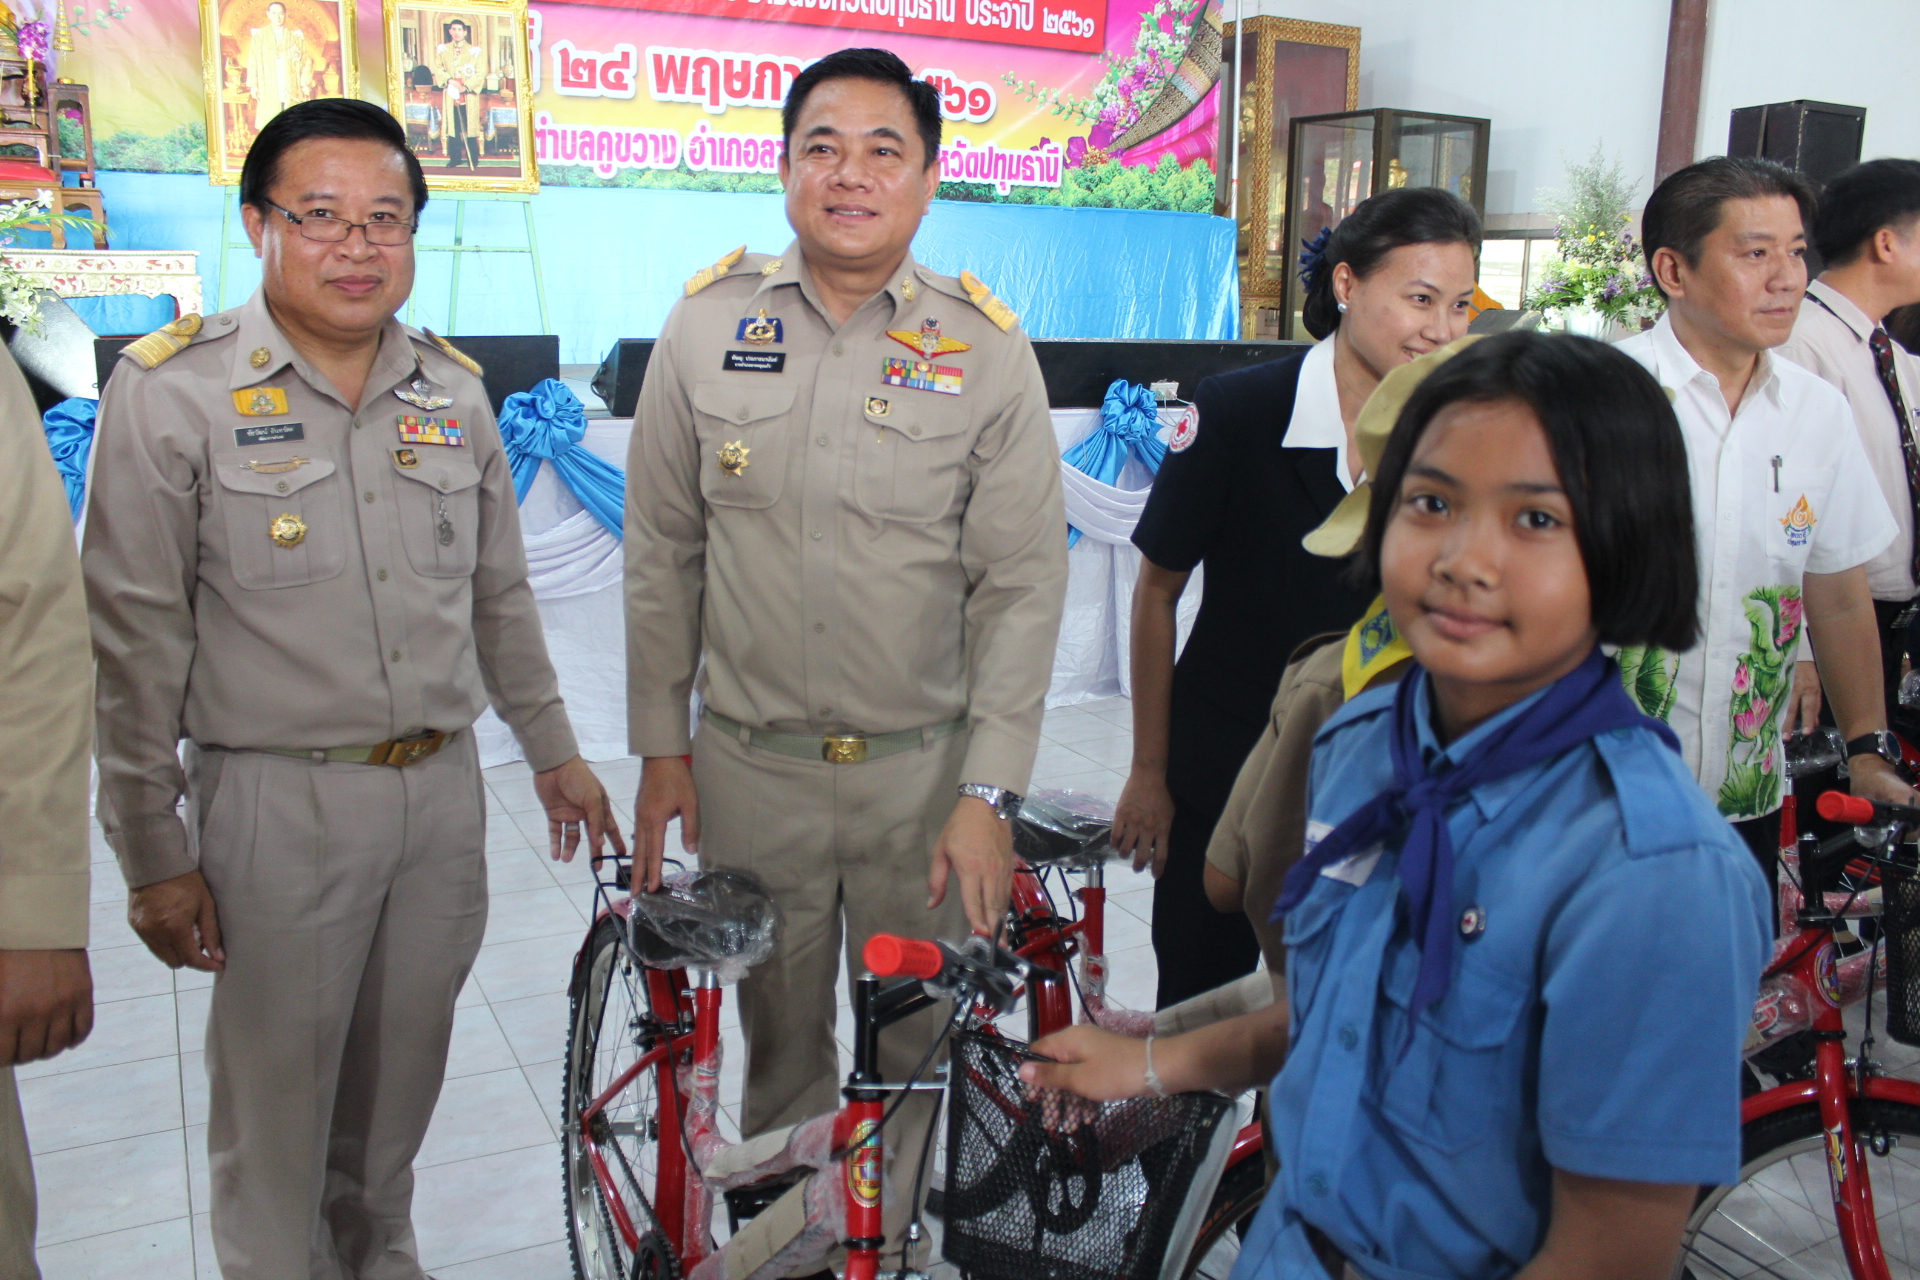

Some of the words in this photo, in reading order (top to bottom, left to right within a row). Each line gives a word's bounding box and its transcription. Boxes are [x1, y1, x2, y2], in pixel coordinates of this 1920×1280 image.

[1042, 6, 1095, 38] ๒๕๖๑
[557, 47, 631, 92] ๒๔
[535, 116, 677, 174] ตำบลคูขวาง
